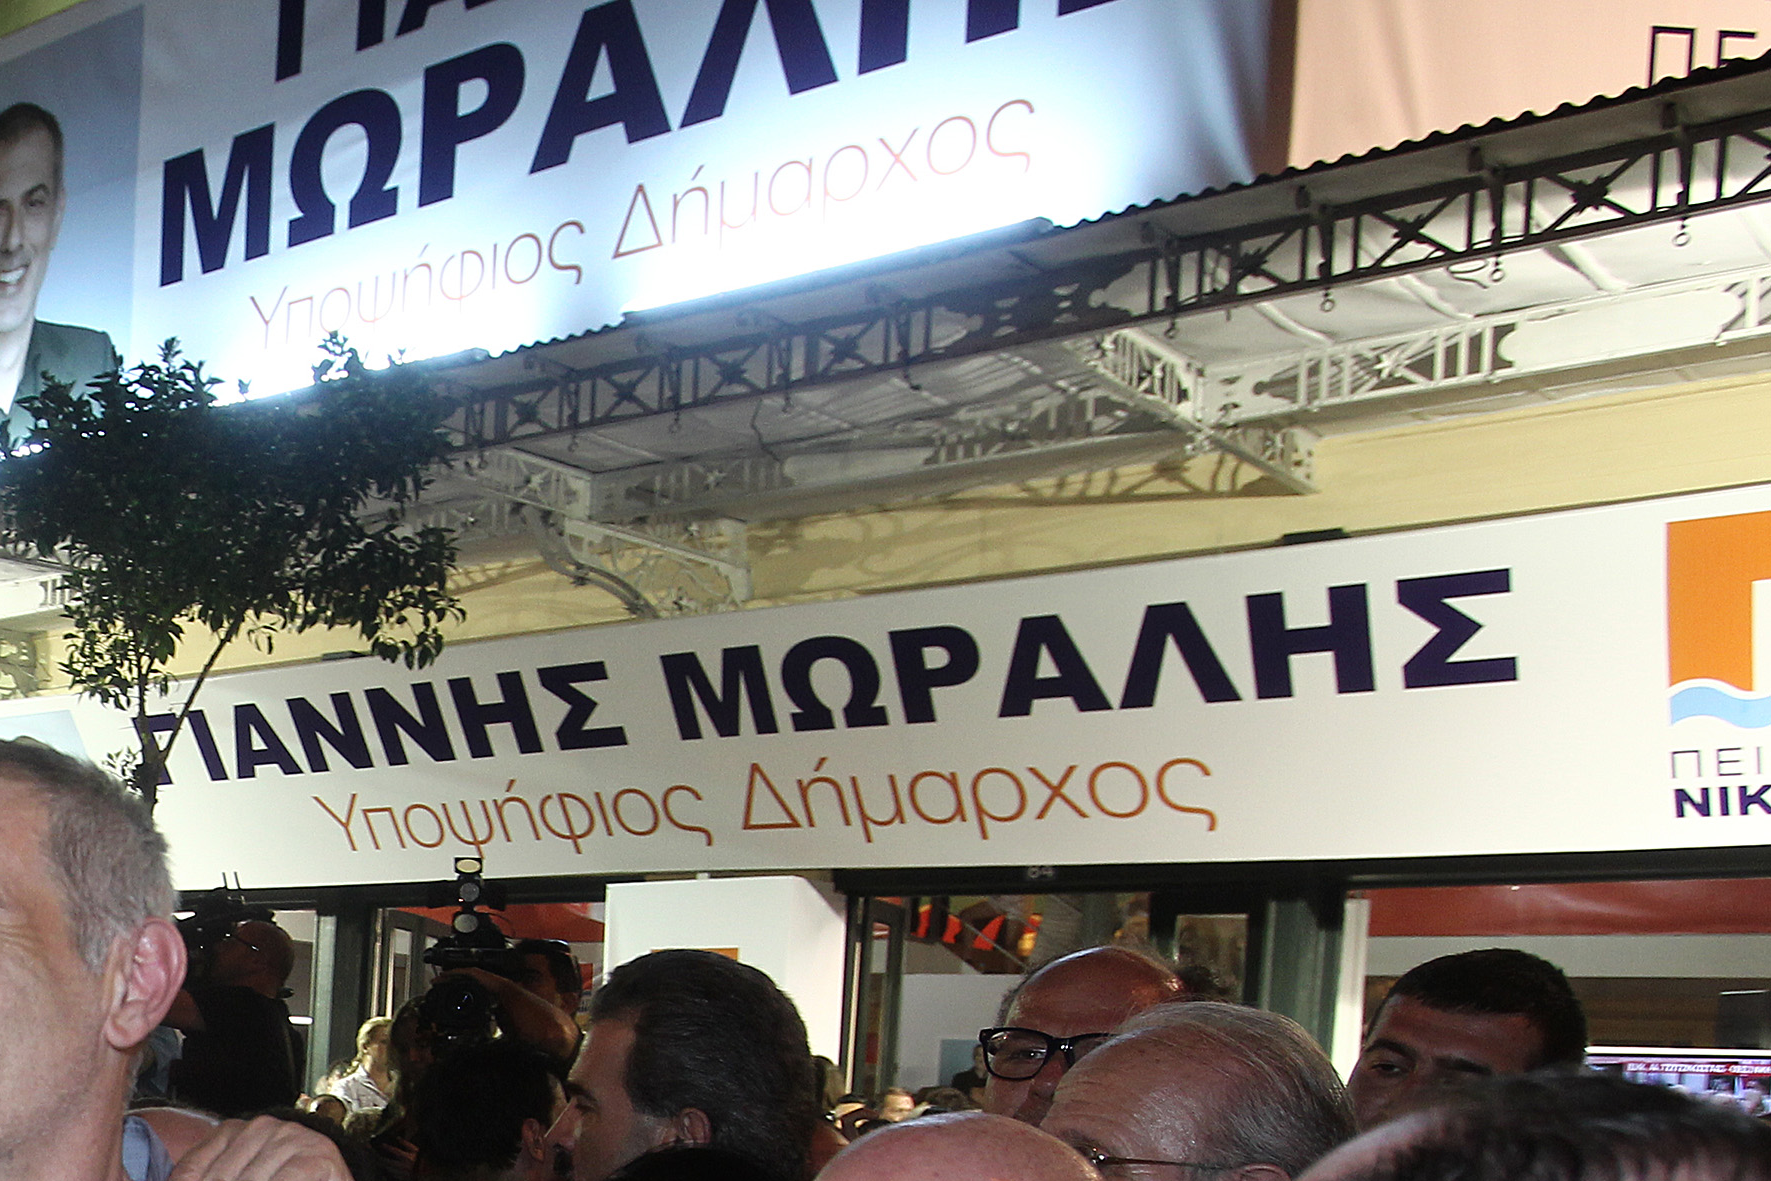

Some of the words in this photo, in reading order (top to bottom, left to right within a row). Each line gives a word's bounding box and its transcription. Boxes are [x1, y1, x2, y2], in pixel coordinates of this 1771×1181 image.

[159, 0, 1118, 288] ΜΩΡΑΛ
[249, 220, 586, 350] Υποψήφιος
[613, 98, 1035, 260] Δήμαρχος
[660, 567, 1519, 741] ΜΩΡΑΛΗΣ
[312, 778, 714, 860] Υποψήφιος
[742, 756, 1216, 844] Δήμαρχος
